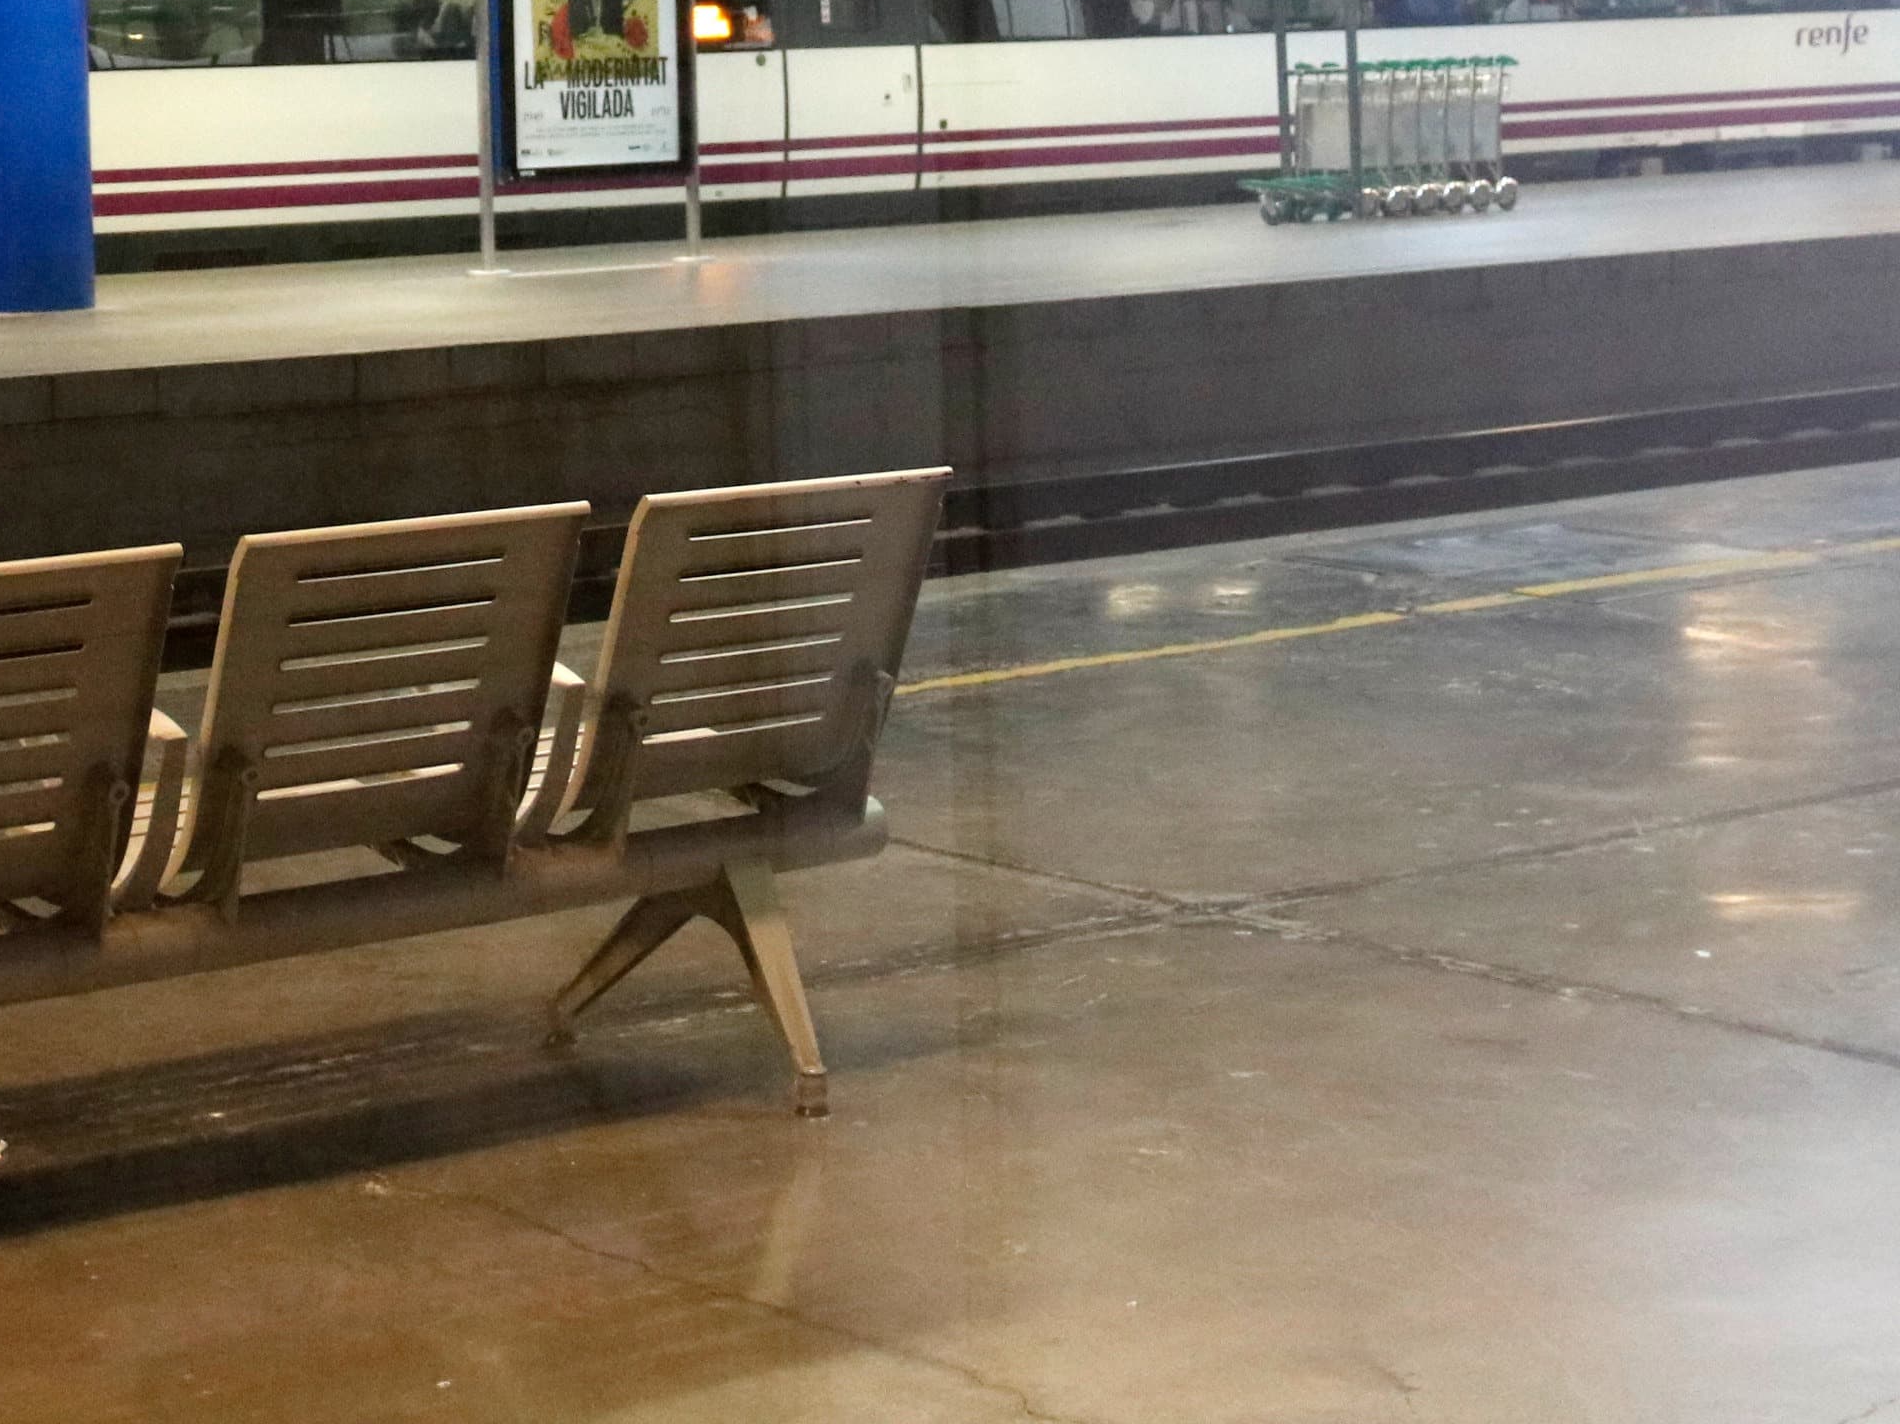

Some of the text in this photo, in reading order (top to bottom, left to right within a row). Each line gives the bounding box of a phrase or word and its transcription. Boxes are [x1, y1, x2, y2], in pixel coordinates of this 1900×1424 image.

[1795, 13, 1869, 56] renfe
[524, 57, 668, 90] LA MODERNITAT
[560, 89, 635, 120] VIGILADA
